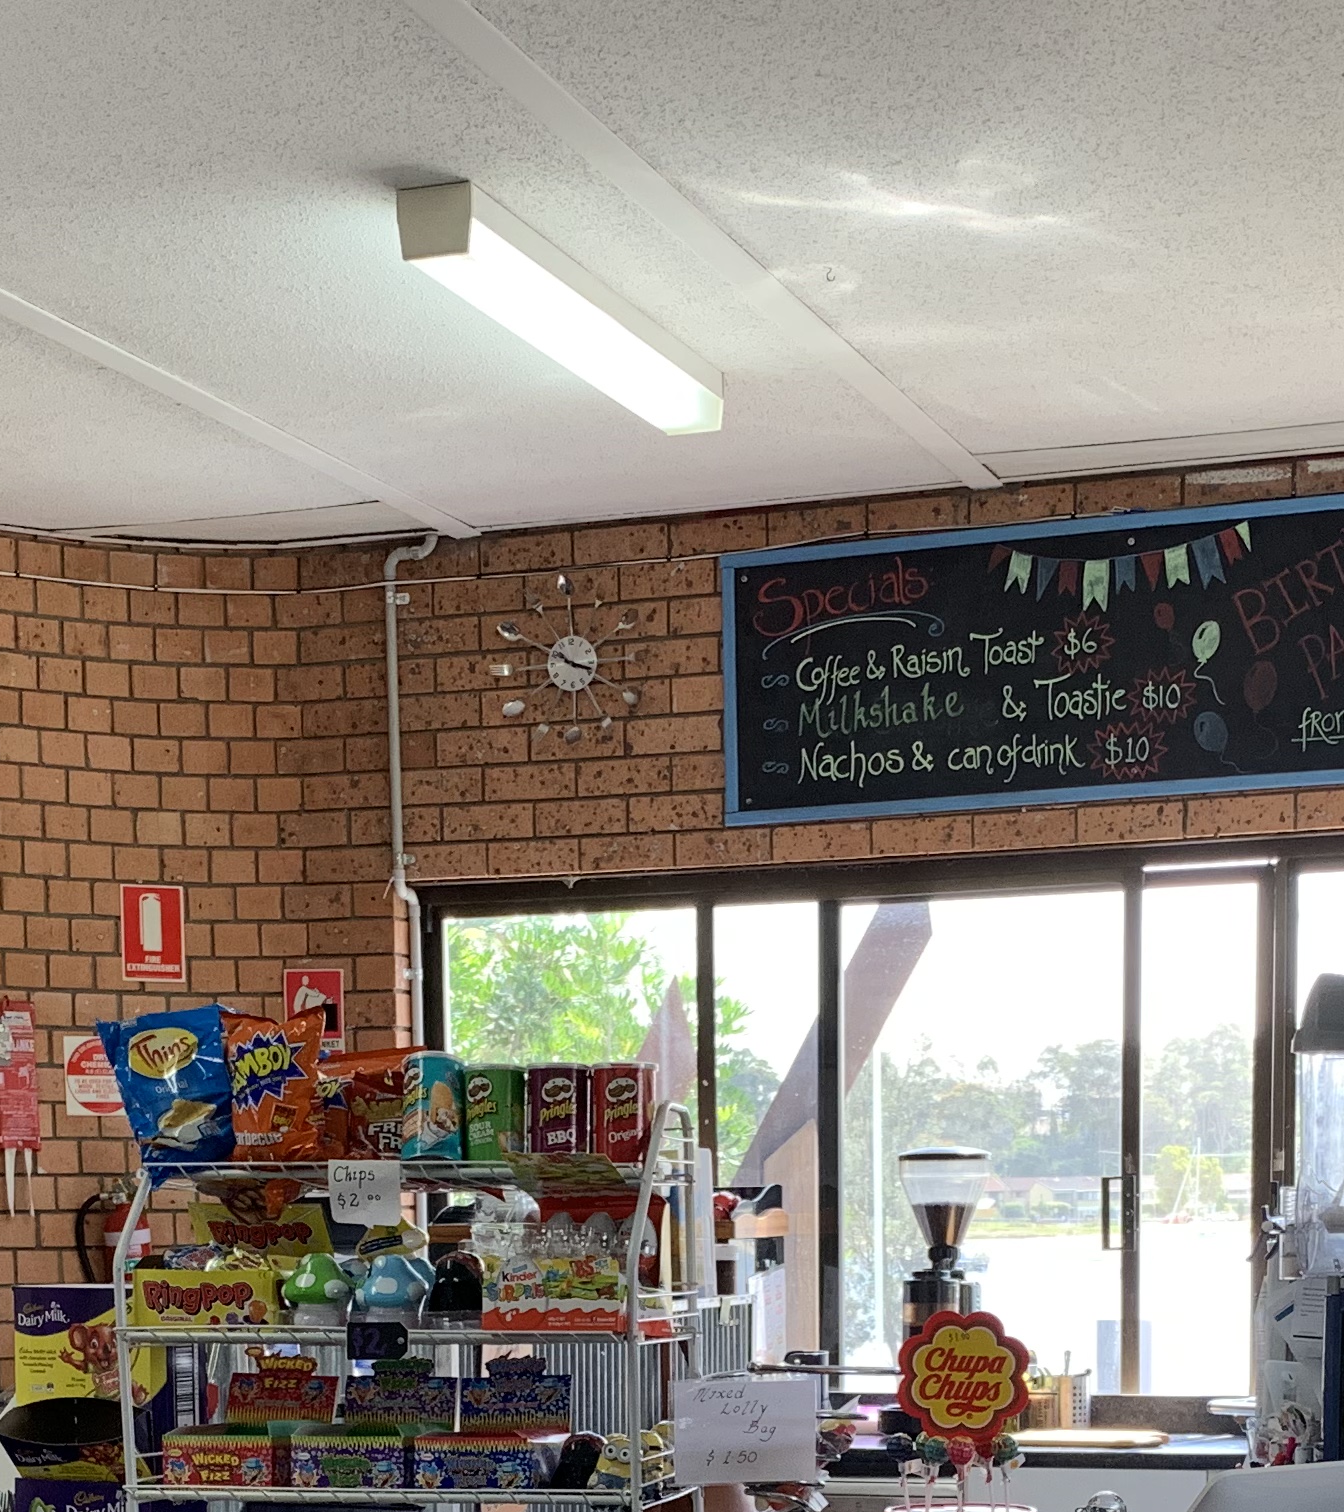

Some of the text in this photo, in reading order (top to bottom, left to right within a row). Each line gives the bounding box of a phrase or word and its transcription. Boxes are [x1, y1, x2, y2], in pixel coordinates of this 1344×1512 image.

[796, 628, 1098, 705] Coffee & Raisin Toast $6
[798, 673, 1180, 738] Milkshake & Toastie $10
[798, 740, 904, 788] Nachos
[912, 741, 934, 772] &
[948, 744, 994, 775] can
[1105, 733, 1150, 769] $10
[126, 963, 181, 973] EXTINGUISHER
[144, 955, 162, 964] FIRE
[130, 1034, 192, 1070] Thins
[231, 1043, 292, 1096] AMBOY
[604, 1100, 639, 1127] Pringle
[235, 1131, 284, 1146] arbecue
[546, 1129, 576, 1146] BBQ
[333, 1166, 376, 1189] Chips
[17, 1311, 45, 1328] Dairy
[258, 1356, 314, 1373] WICKED
[924, 1346, 1008, 1380] Chupa
[263, 1378, 298, 1389] FIZZ
[918, 1373, 1004, 1417] Chups
[720, 1400, 768, 1421] Lolly
[742, 1420, 777, 1443] Bag
[191, 1452, 240, 1467] WICKED
[199, 1470, 231, 1482] FIZZ
